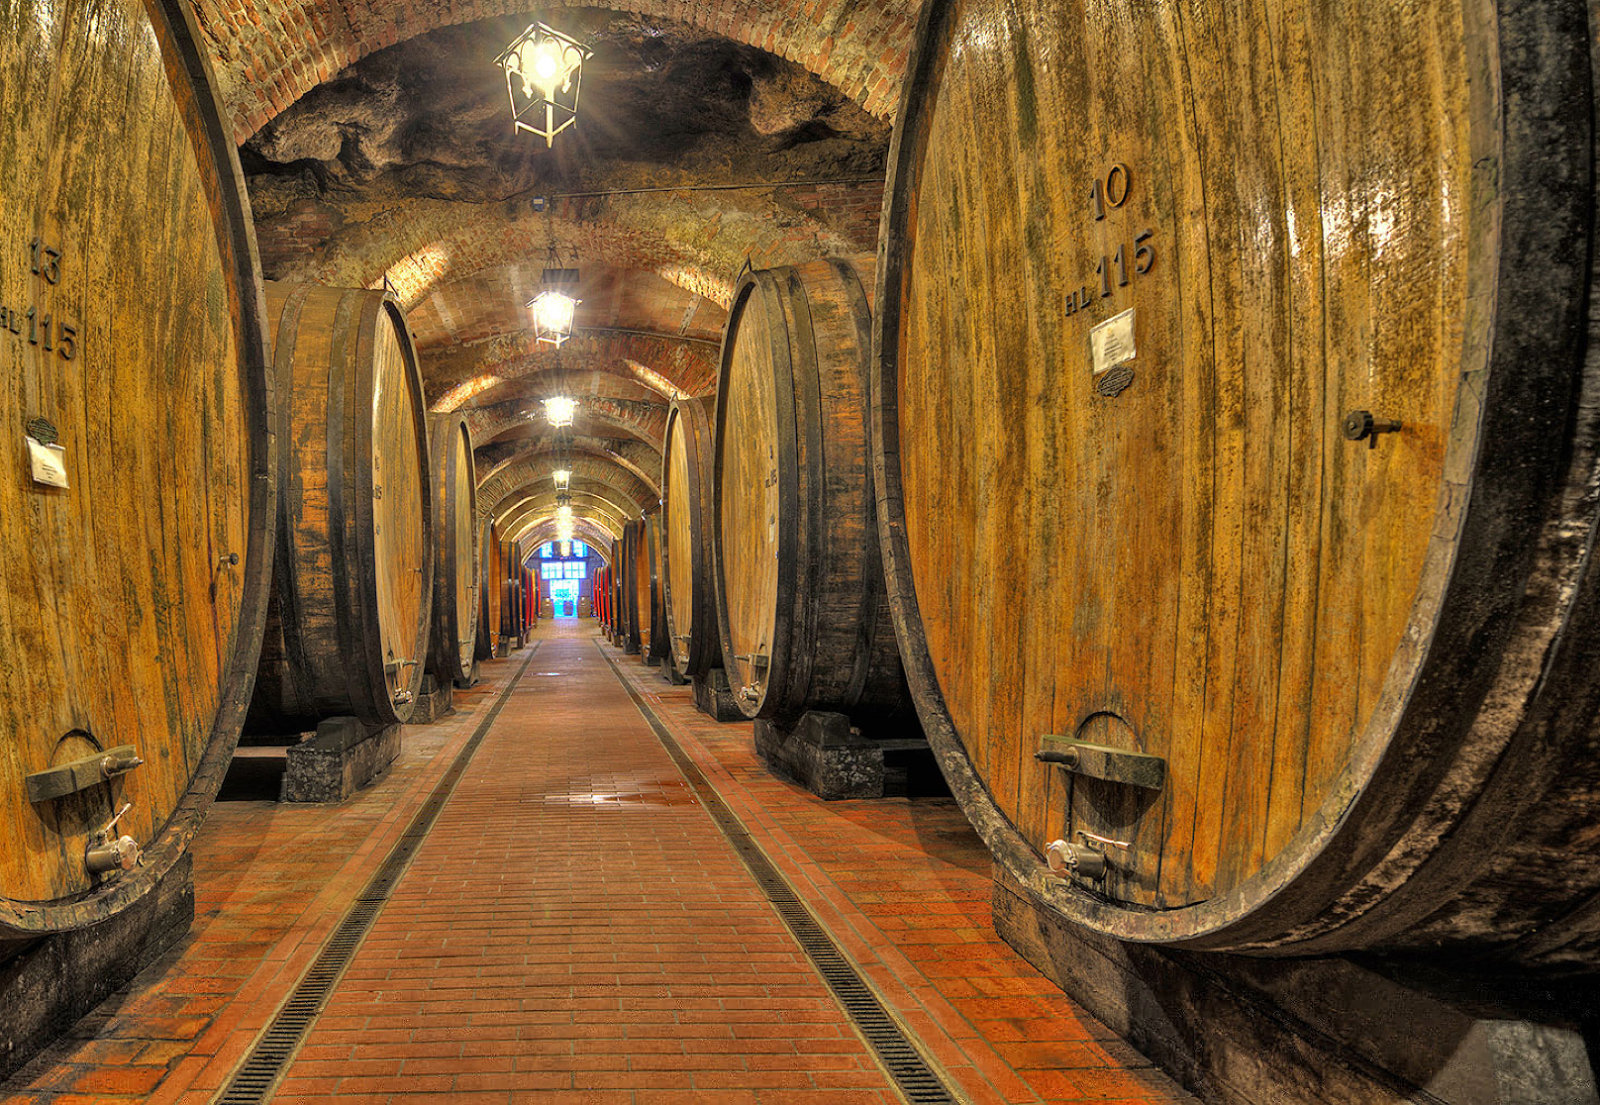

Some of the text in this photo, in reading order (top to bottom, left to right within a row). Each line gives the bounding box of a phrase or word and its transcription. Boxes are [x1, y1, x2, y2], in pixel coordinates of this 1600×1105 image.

[1089, 162, 1131, 221] 10
[29, 236, 62, 285] 13
[1064, 228, 1156, 317] HL 115
[27, 305, 77, 361] 115
